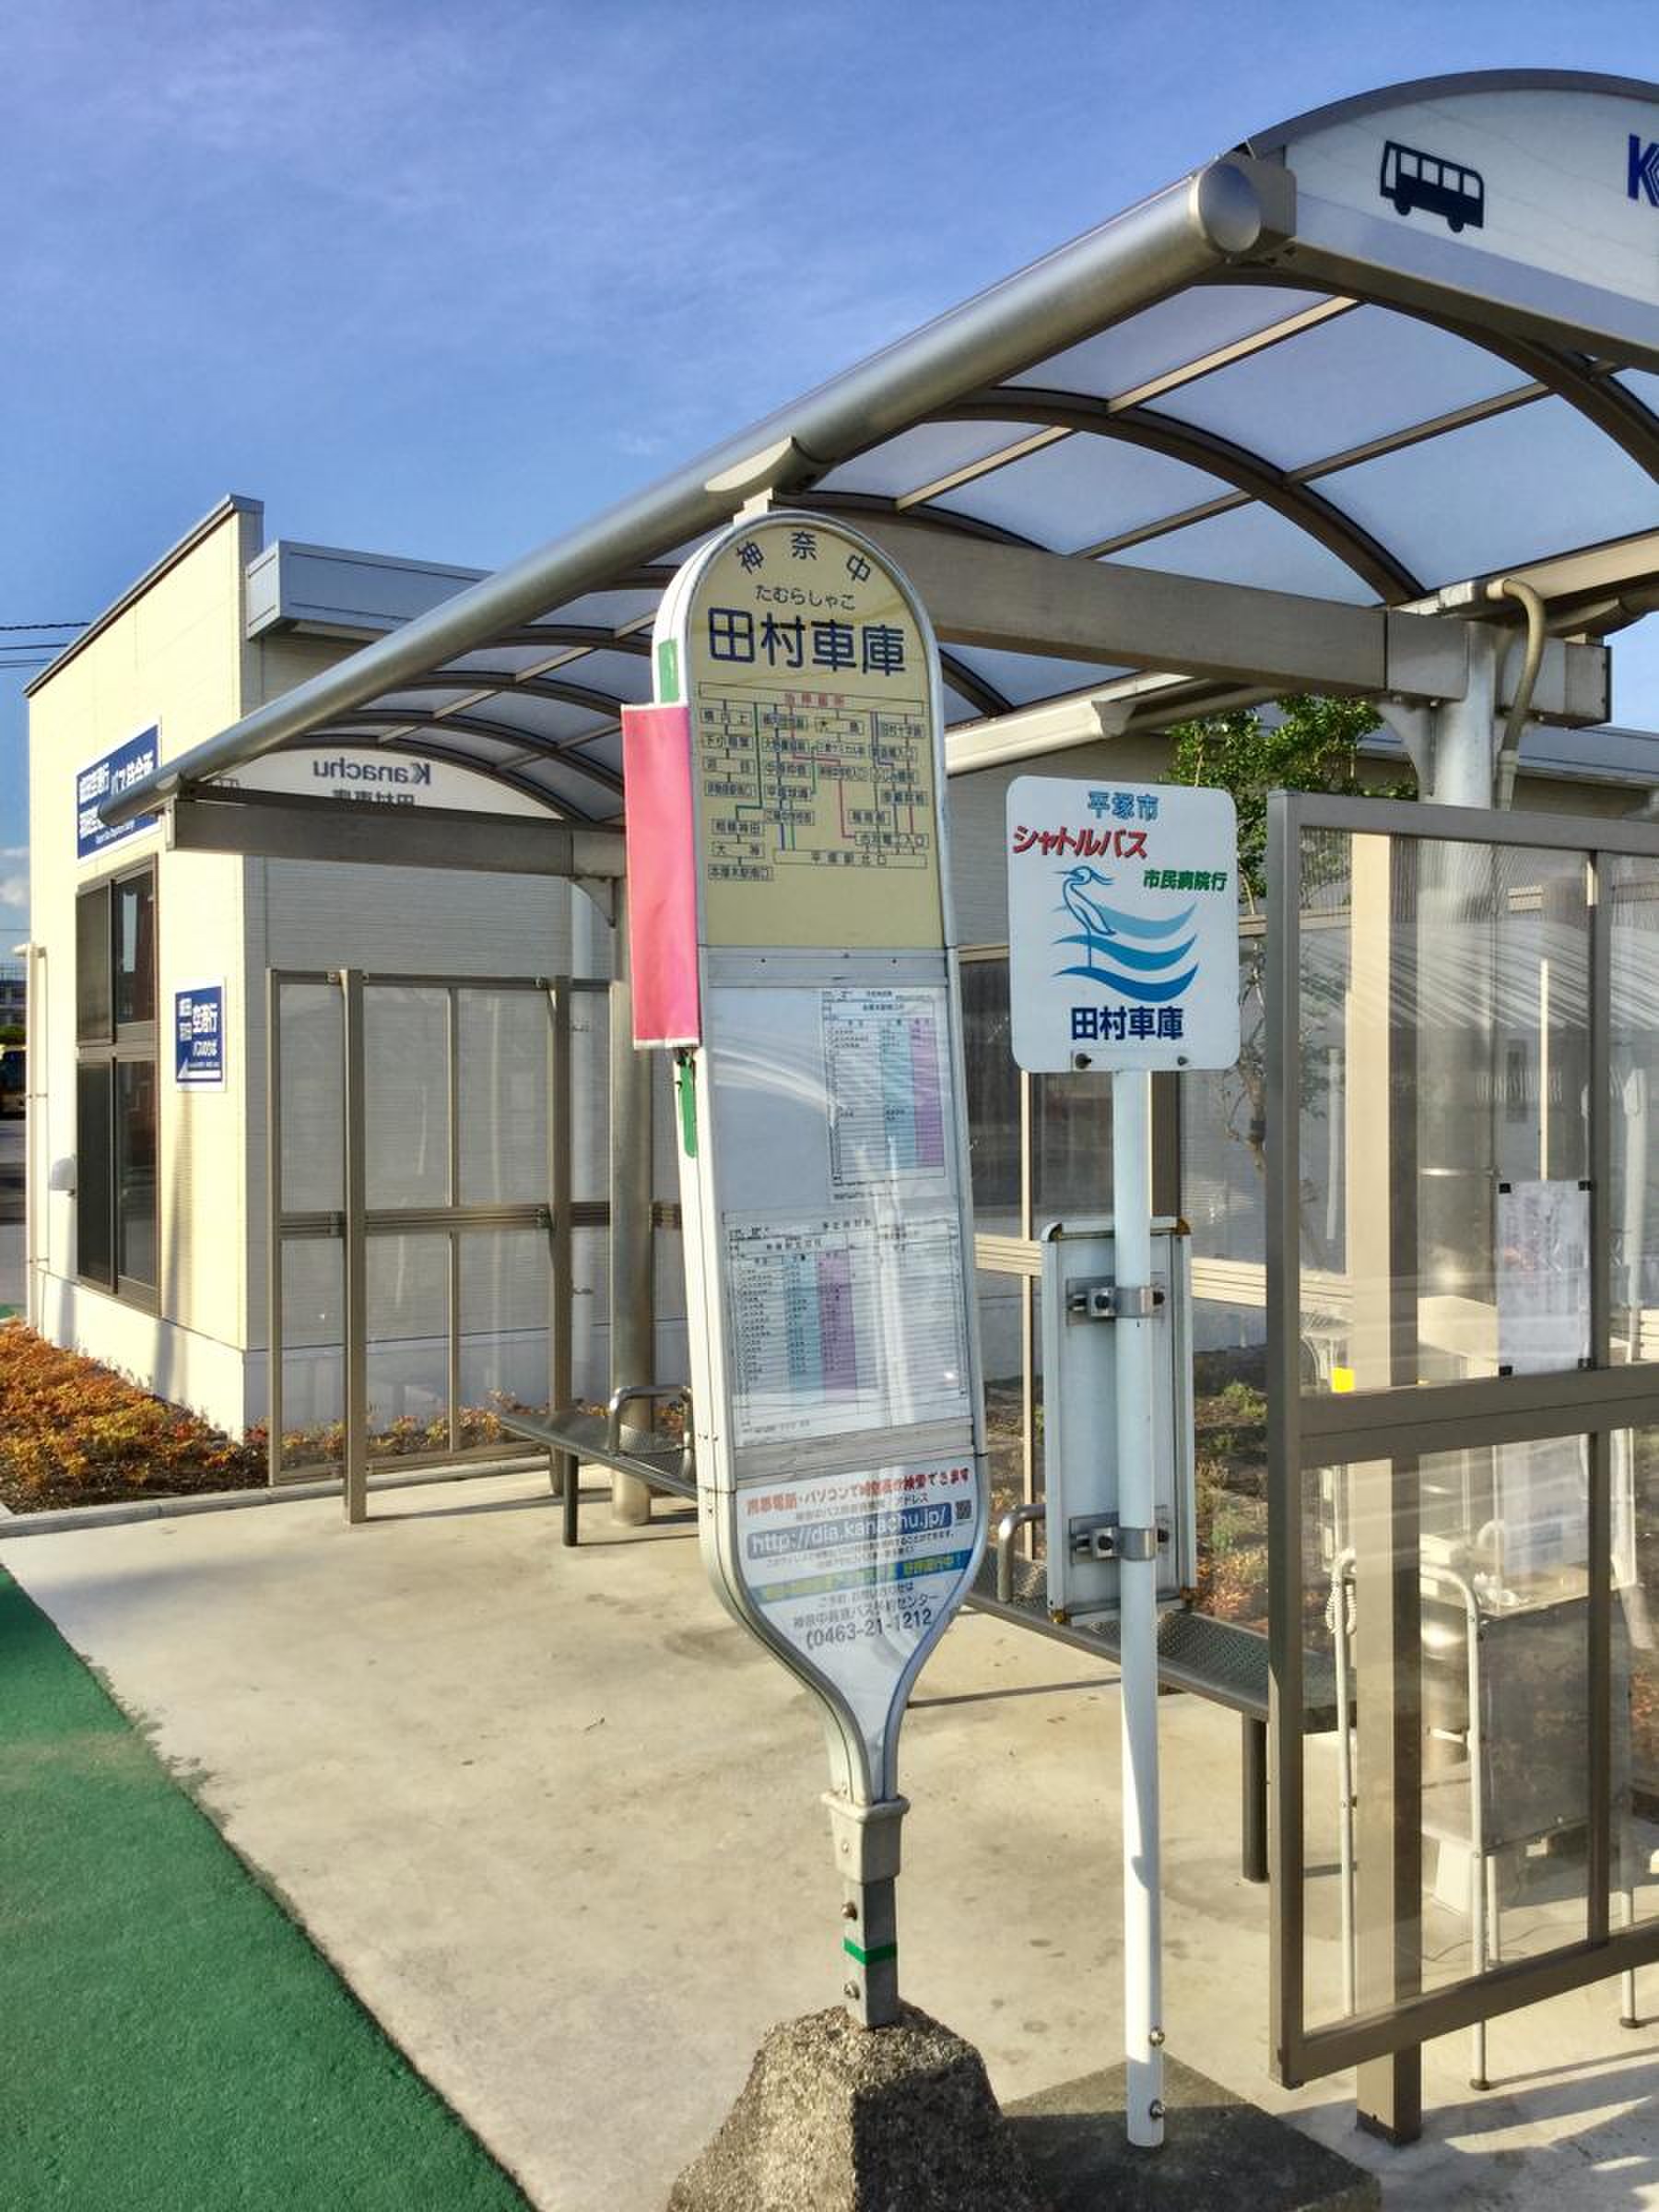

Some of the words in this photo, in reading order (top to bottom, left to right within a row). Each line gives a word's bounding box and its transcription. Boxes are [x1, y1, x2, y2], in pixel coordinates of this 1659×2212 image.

[756, 584, 856, 611] たむらしゃこ
[707, 606, 906, 677] 田村車庫
[1087, 791, 1159, 821] 平塚市
[1013, 825, 1148, 860] シャトルバス
[1143, 869, 1228, 892] 市民病院行
[1070, 1006, 1184, 1041] 田村車庫
[751, 1503, 947, 1552] http://dia.kanachu.jp/
